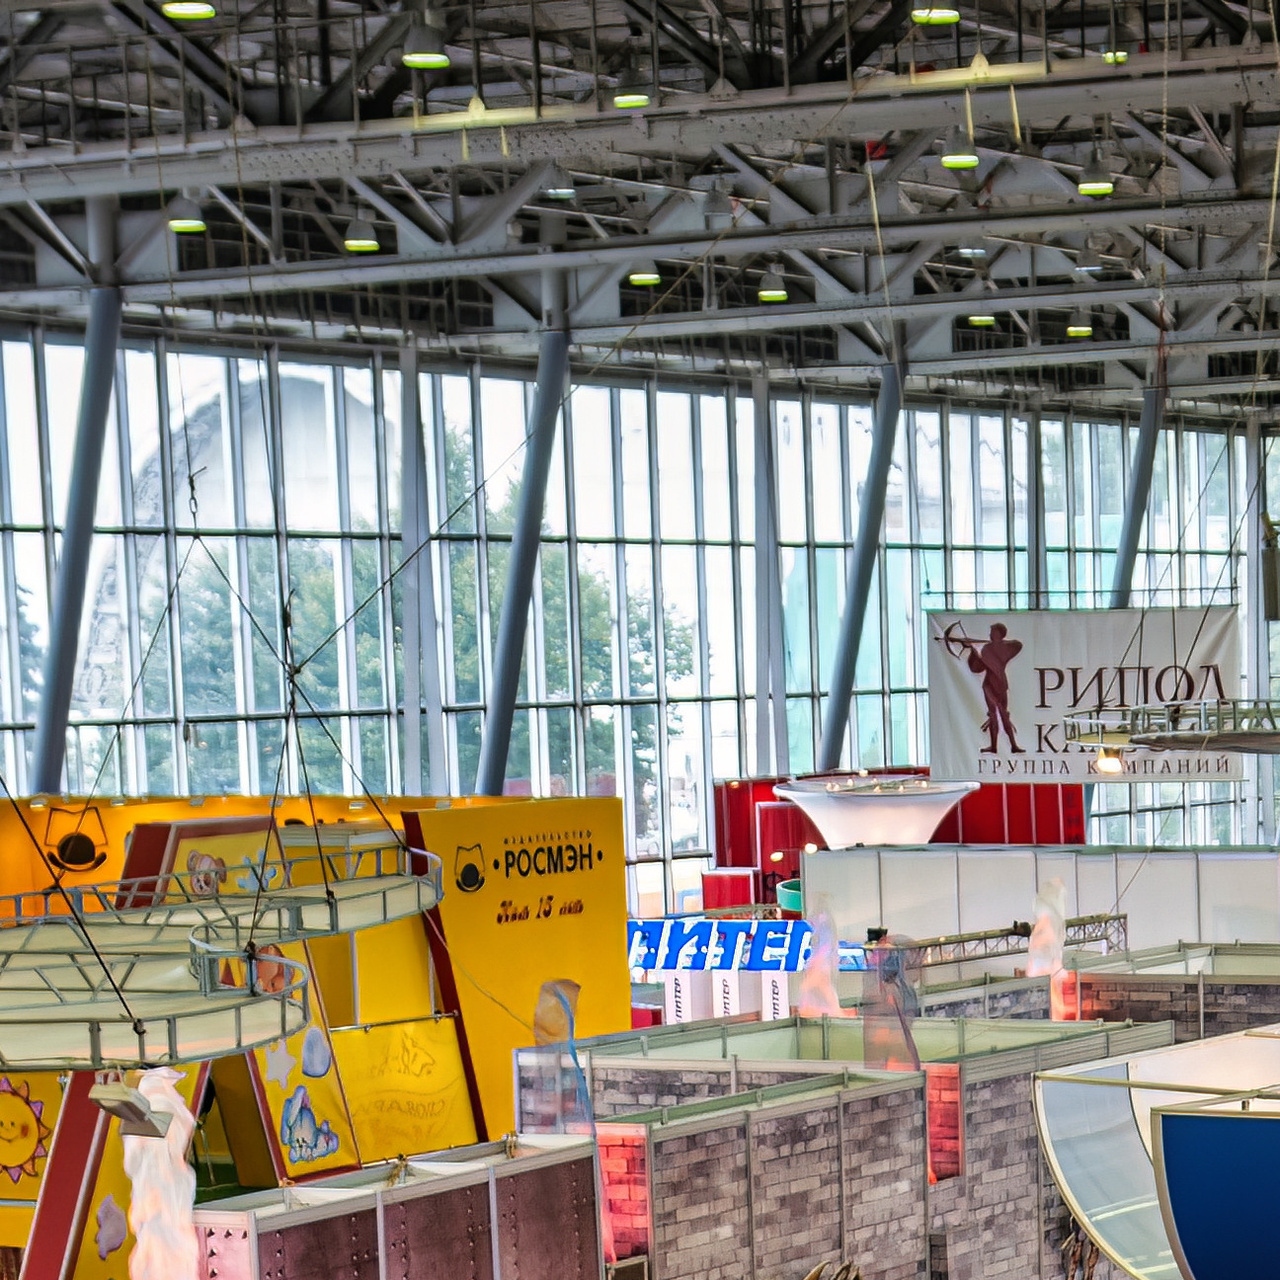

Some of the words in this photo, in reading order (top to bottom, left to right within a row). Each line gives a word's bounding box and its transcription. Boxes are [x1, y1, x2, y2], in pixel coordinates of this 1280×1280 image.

[1034, 665, 1230, 708] РИПОЛ
[977, 758, 1071, 775] ГРУППА
[1087, 754, 1230, 775] КМПАНИЙ
[504, 842, 594, 879] РОСМЭН
